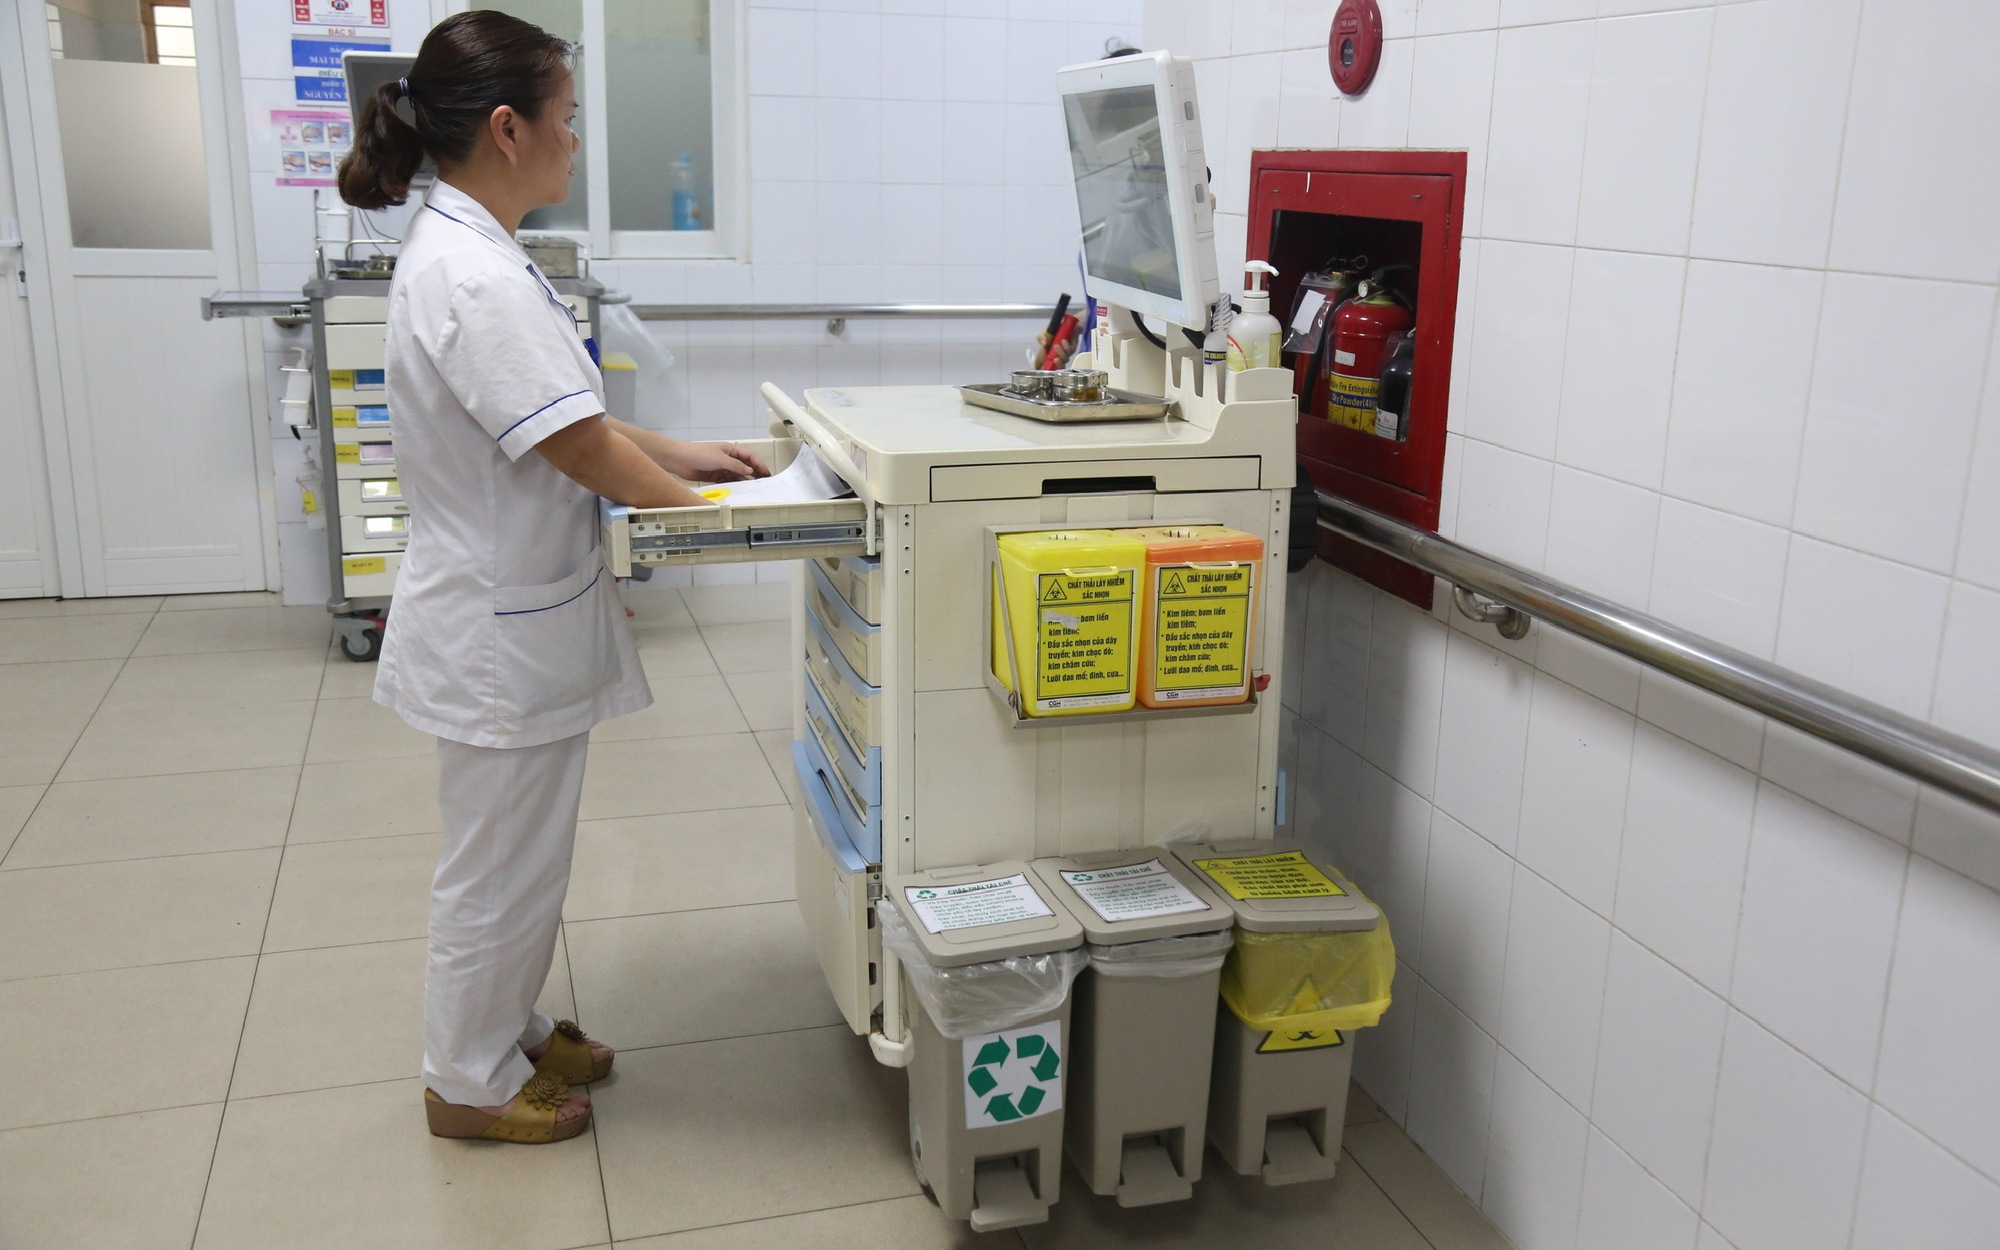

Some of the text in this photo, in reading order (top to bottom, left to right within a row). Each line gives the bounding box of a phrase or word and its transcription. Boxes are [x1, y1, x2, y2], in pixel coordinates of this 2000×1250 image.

[1339, 381, 1347, 390] Fire
[1349, 383, 1379, 396] Extinguishe
[1048, 662, 1060, 670] kim
